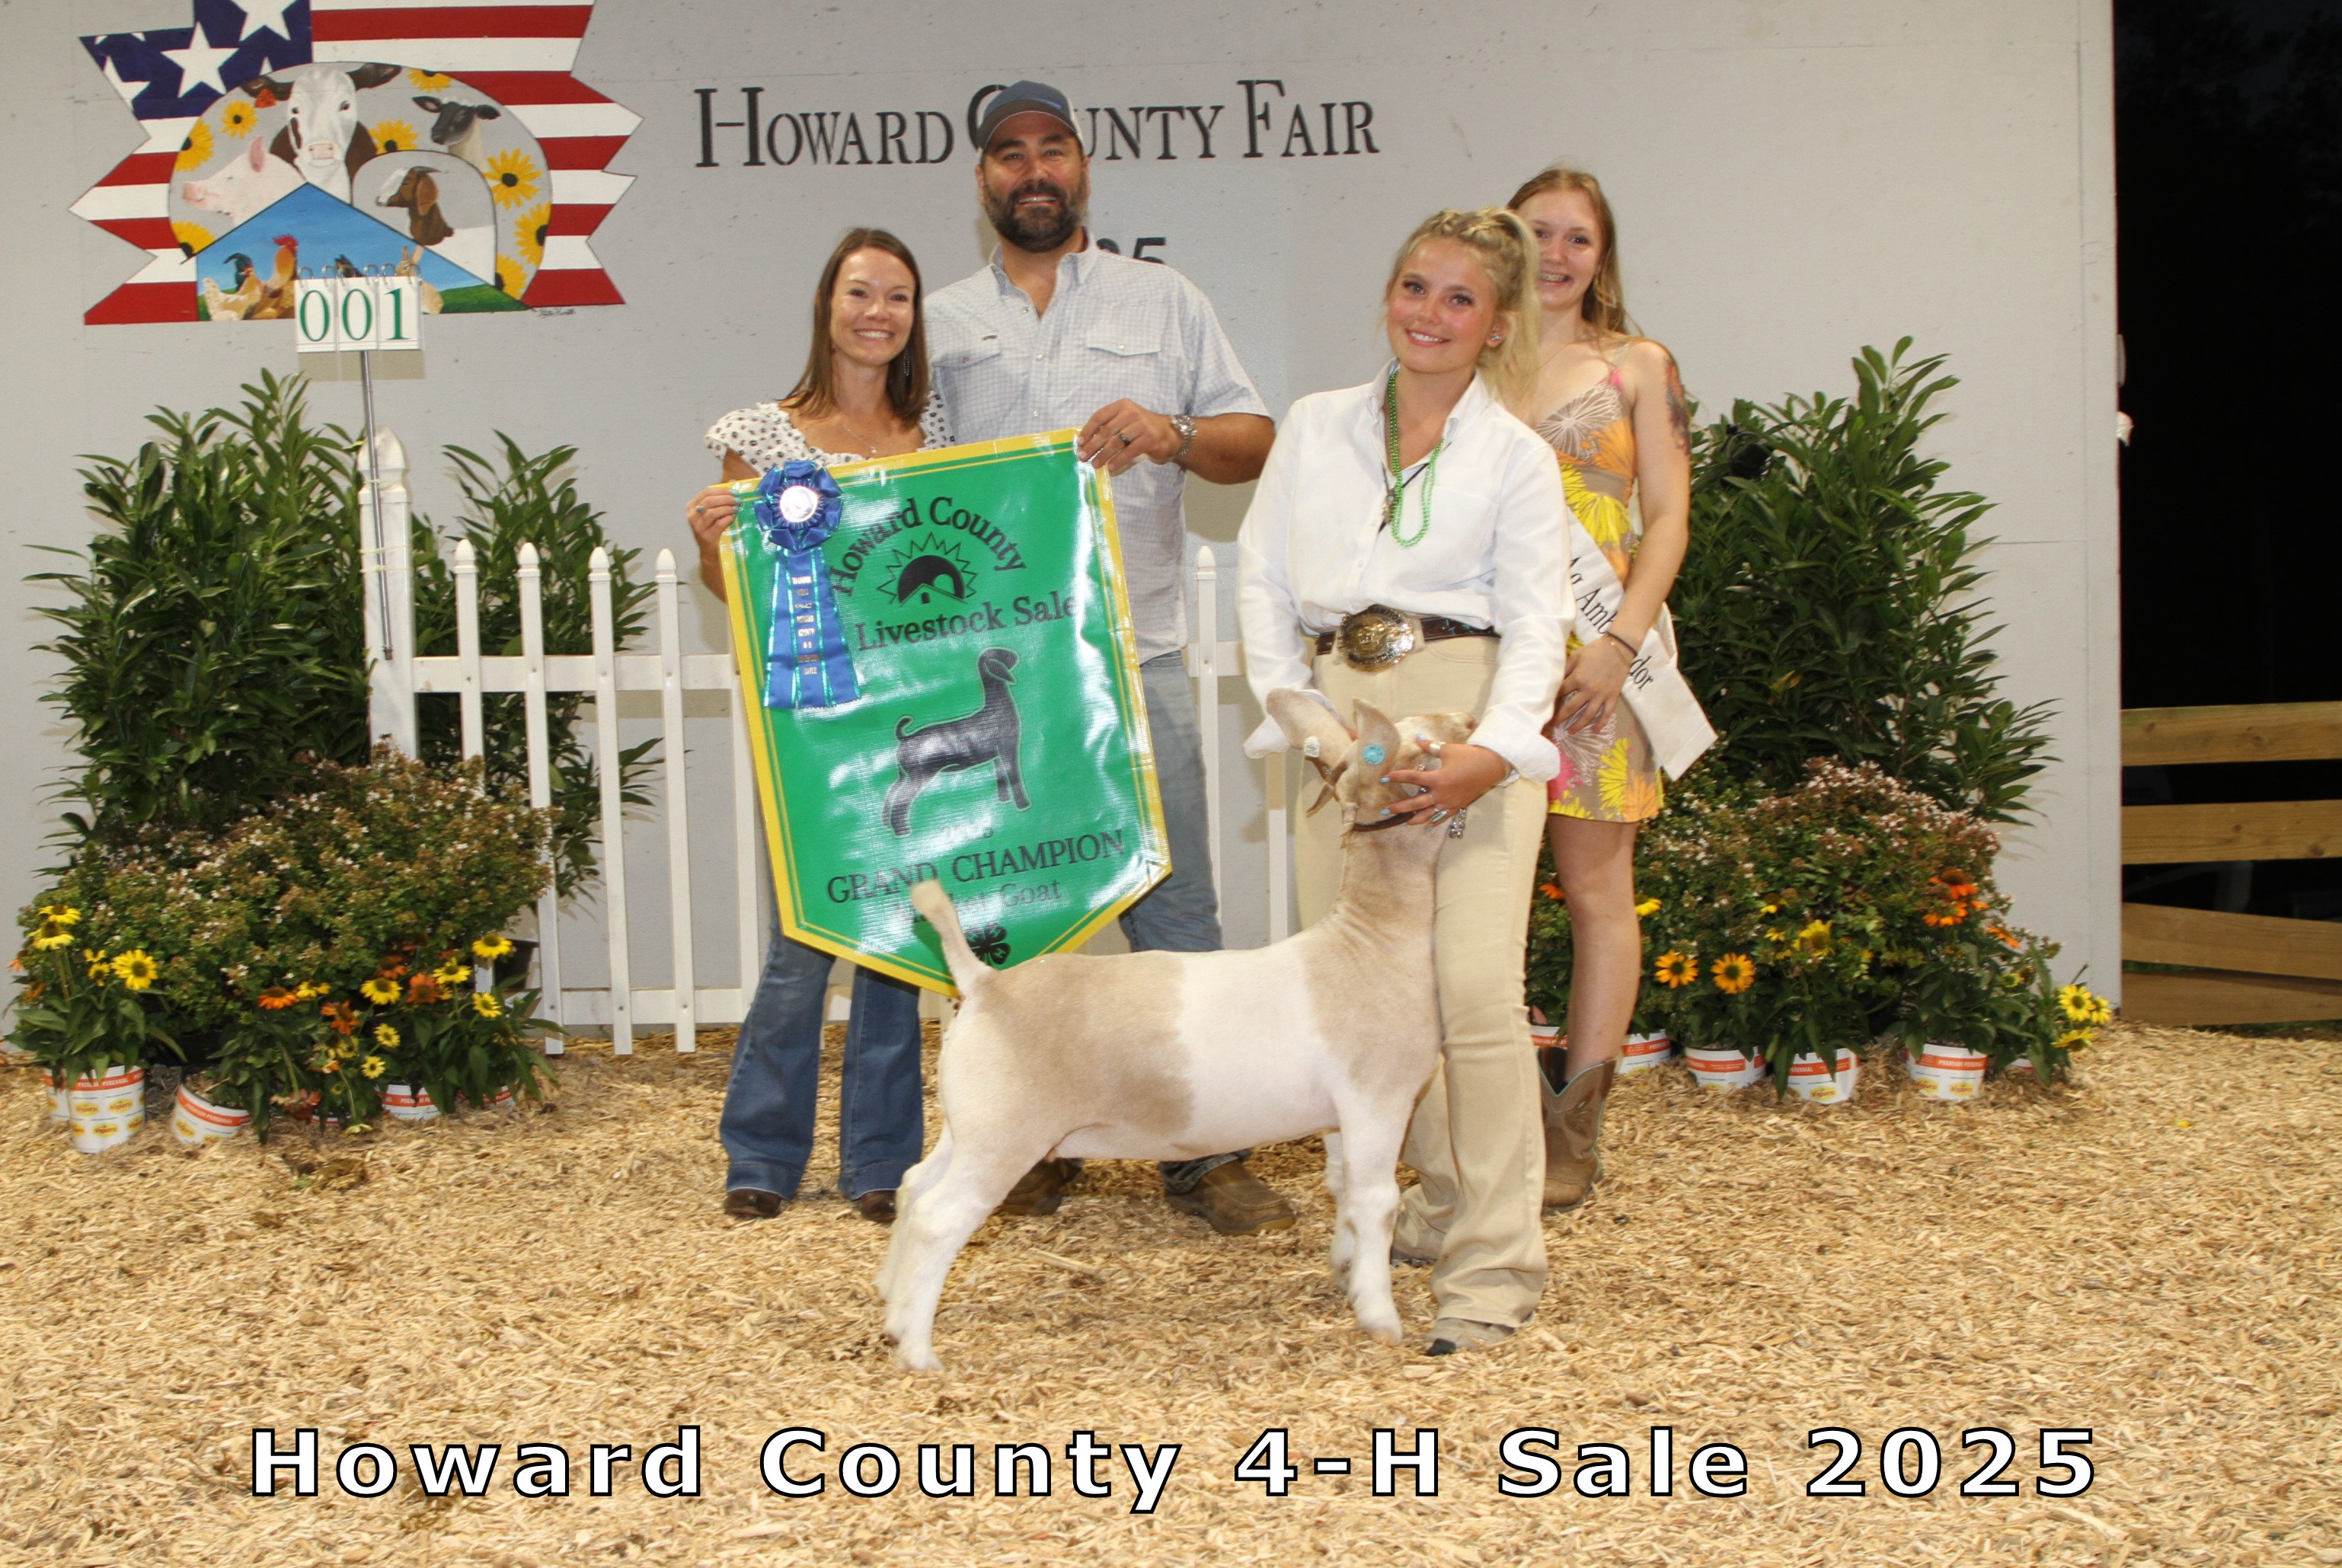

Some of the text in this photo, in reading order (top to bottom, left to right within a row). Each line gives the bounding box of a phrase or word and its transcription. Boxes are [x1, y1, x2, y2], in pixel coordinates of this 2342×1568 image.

[300, 288, 412, 342] 001
[830, 496, 1027, 597] Howard County
[855, 601, 1007, 651] Livestock
[952, 829, 1125, 883] CHAMPION
[1000, 878, 1062, 908] Goat
